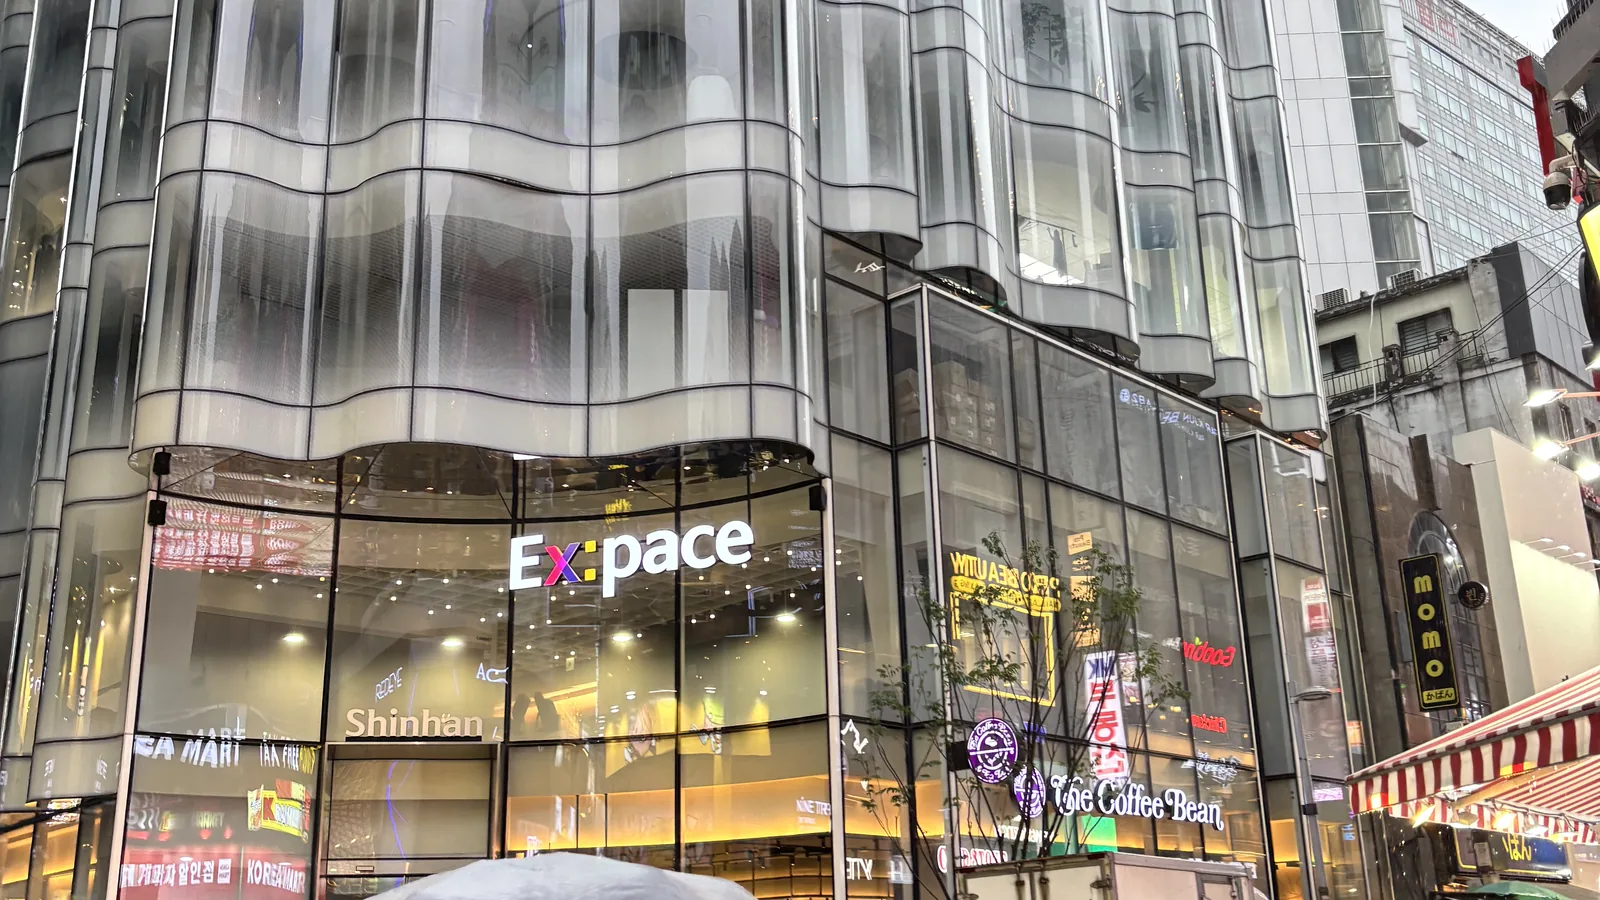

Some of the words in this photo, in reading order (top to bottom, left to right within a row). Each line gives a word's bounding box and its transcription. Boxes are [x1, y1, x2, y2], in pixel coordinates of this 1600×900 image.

[508, 520, 756, 599] Ex:pace
[1413, 574, 1444, 678] momo
[1425, 689, 1454, 702] かばん
[345, 707, 483, 737] Shinhan
[1050, 773, 1094, 817] The
[1097, 778, 1164, 819] Coffee
[1164, 788, 1225, 832] Bean
[1502, 833, 1532, 861] ばん
